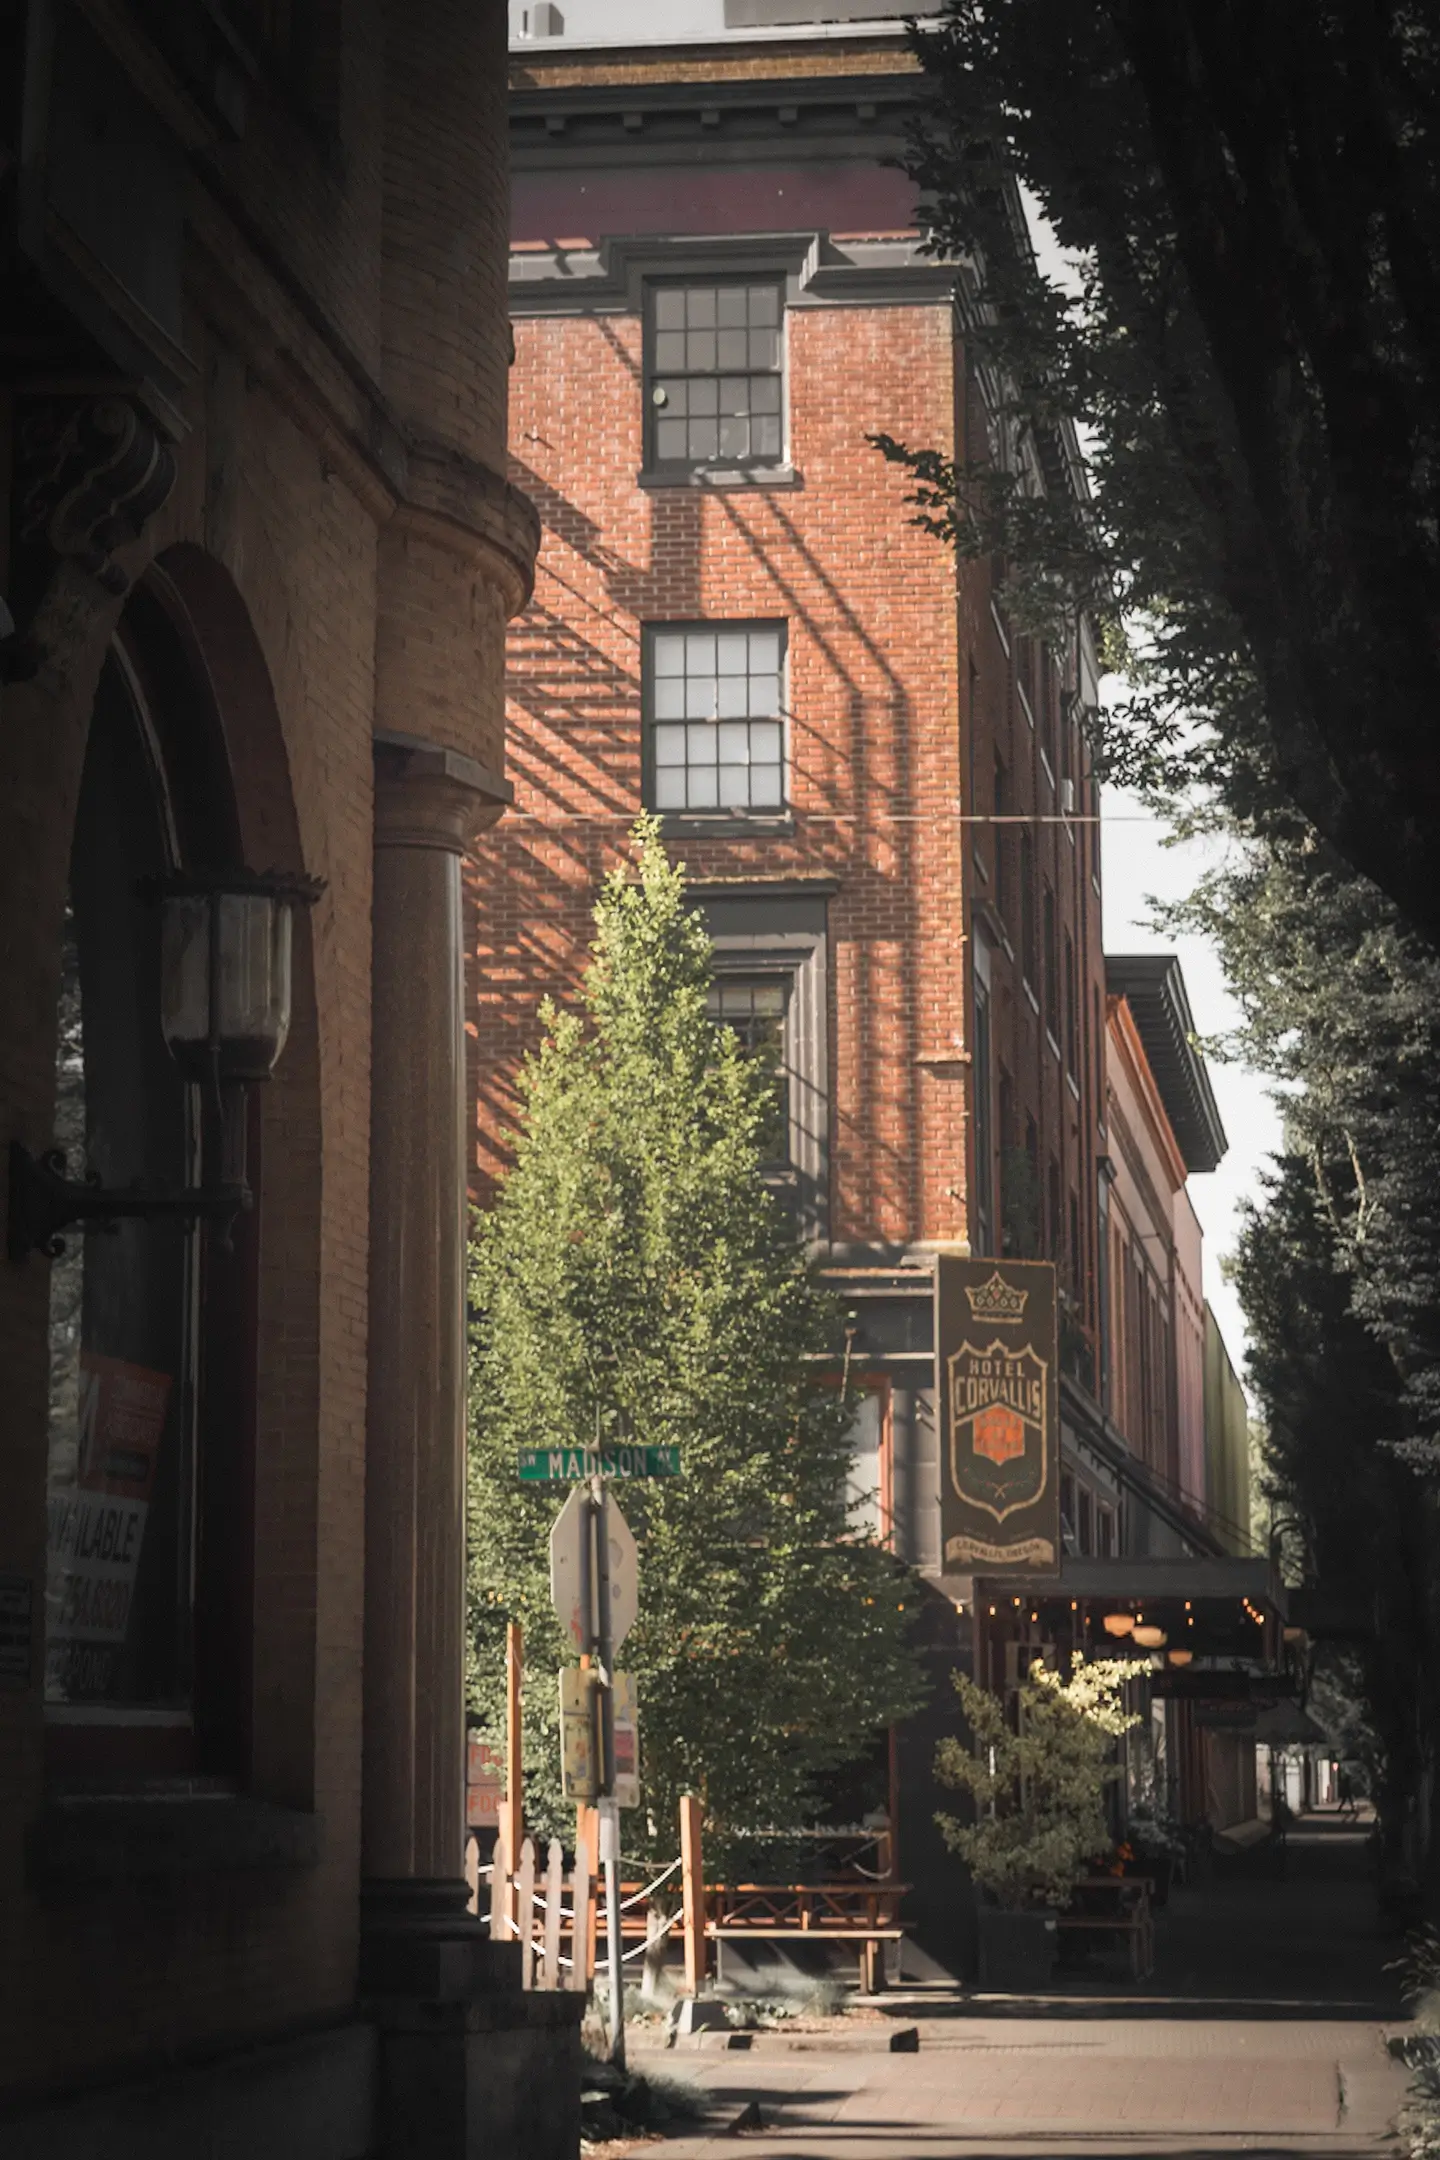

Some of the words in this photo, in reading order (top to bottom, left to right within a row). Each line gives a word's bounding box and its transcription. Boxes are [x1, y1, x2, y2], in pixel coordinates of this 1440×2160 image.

[969, 1359, 1025, 1377] HOTEL
[955, 1376, 1040, 1419] CORVALLIS
[548, 1450, 647, 1478] MADISON
